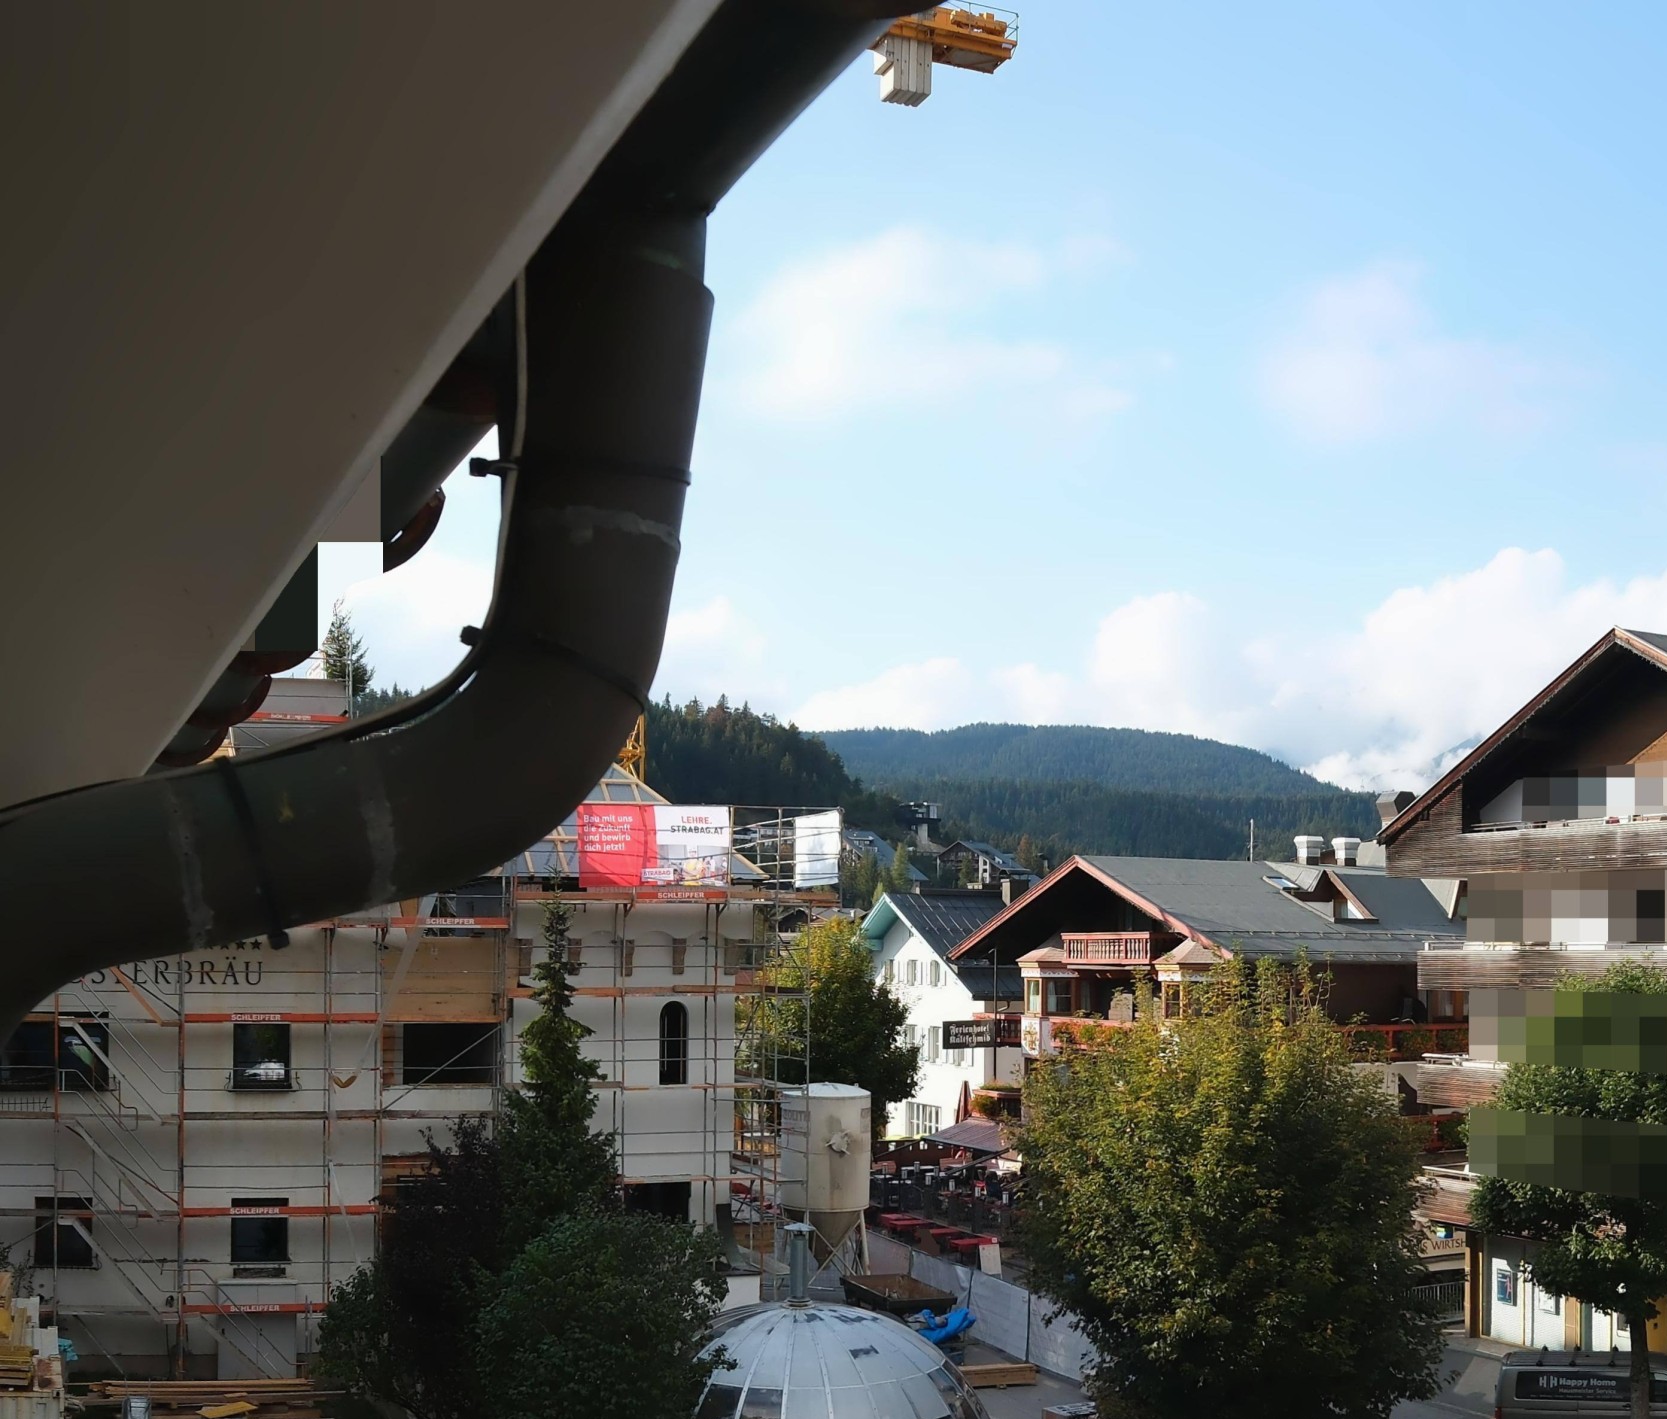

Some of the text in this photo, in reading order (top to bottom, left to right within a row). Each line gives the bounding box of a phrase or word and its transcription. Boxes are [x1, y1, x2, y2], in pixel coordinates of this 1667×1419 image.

[583, 814, 633, 823] Bau mit uns
[680, 815, 713, 825] LEHRE.
[583, 824, 631, 833] die Zukunft
[670, 825, 724, 835] STRABAG.AT
[584, 833, 631, 842] und bewirb
[584, 843, 625, 852] dich jetzt!
[657, 891, 705, 899] SCHLEIPFER
[425, 917, 475, 925] SCHLEIPFER
[231, 1013, 281, 1022] SCHLEIPFER
[230, 1207, 280, 1215] SCHLEIPFER
[230, 1304, 280, 1312] SCHLEIPFER
[1559, 1376, 1617, 1388] Happy Home
